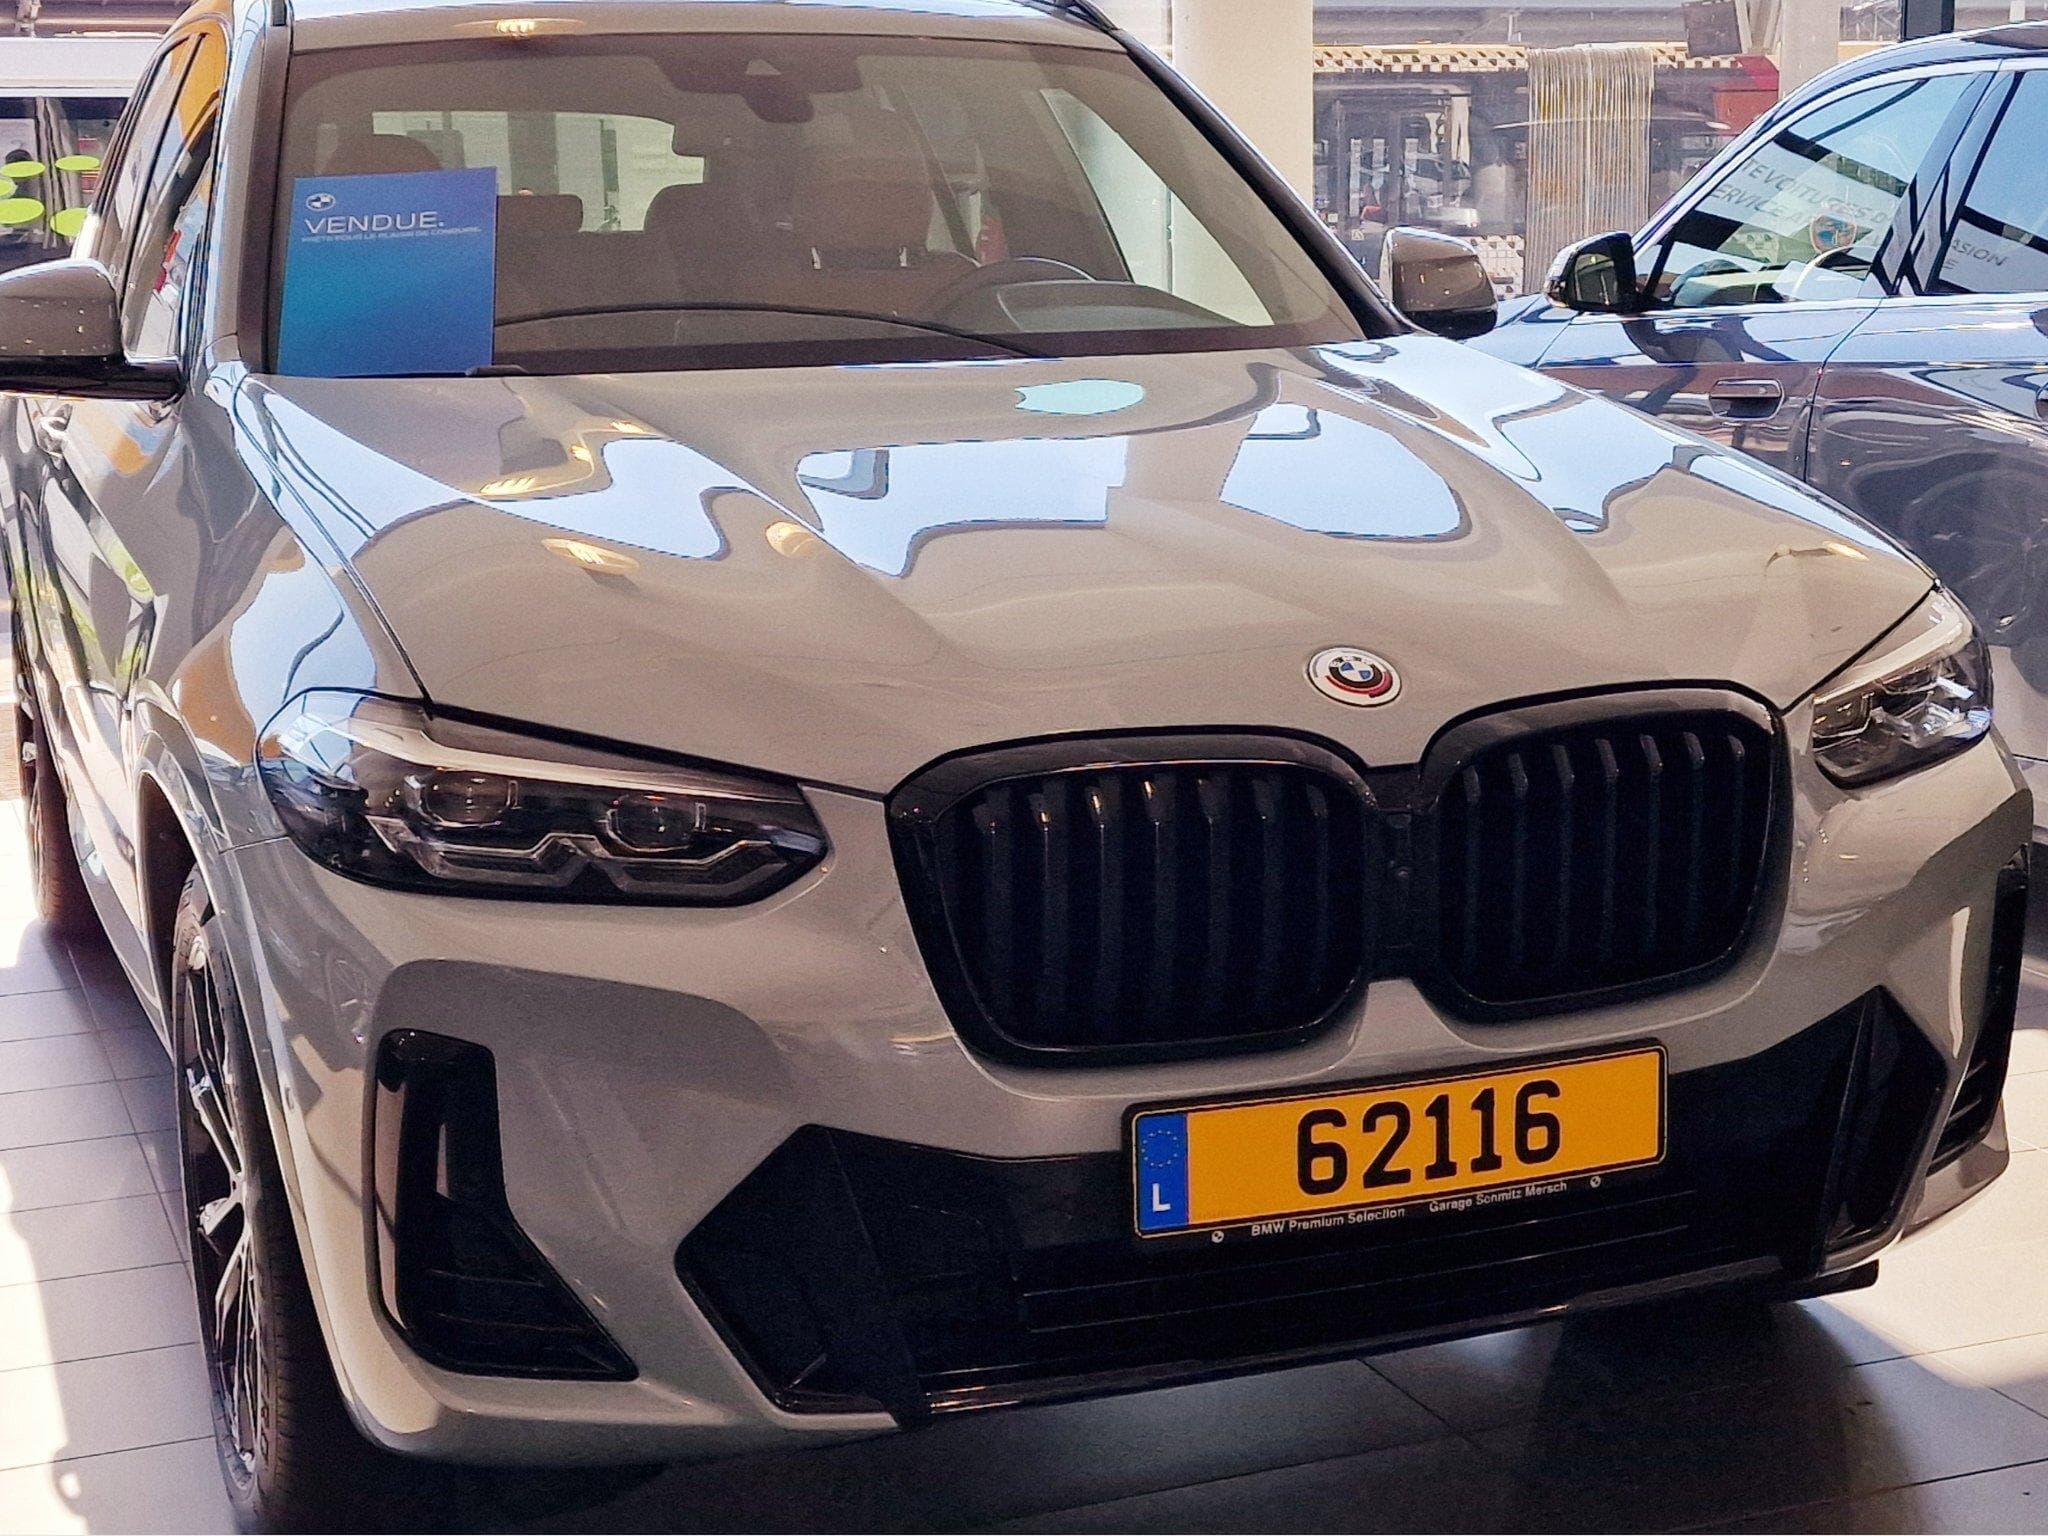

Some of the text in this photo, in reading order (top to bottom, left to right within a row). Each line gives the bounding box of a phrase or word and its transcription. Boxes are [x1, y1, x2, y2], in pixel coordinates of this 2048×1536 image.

[1709, 183, 1786, 218] ERVICE
[304, 210, 445, 234] VENDUE.
[1297, 1079, 1562, 1196] 62116
[1151, 1183, 1171, 1213] L
[1251, 1220, 1286, 1237] BMW
[1289, 1215, 1344, 1231] Premium
[1348, 1207, 1406, 1224] Selection
[1429, 1198, 1472, 1213] Garage
[1525, 1181, 1568, 1197] Mersch
